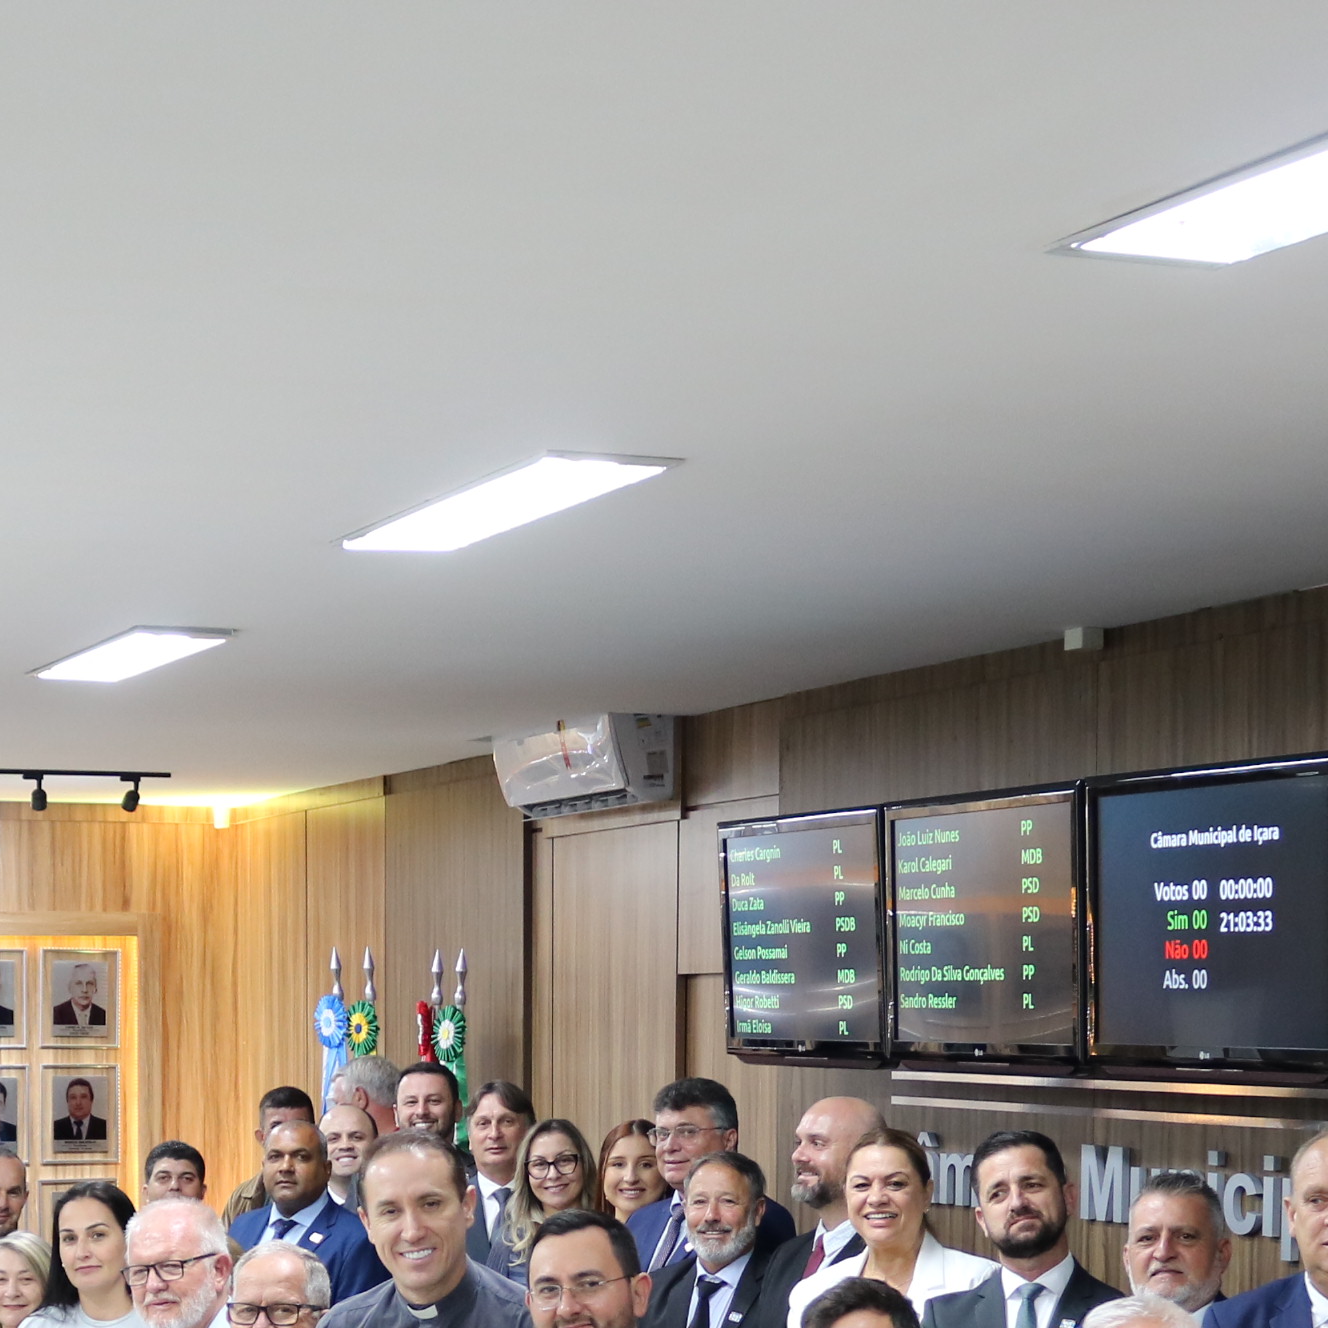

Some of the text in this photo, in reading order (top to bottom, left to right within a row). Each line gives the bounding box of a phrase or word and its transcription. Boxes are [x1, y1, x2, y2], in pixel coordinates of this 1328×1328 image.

[1020, 820, 1033, 836] PP
[897, 829, 960, 848] João Luiz Nunes
[1150, 823, 1280, 850] Câmara Municipal de Içara
[730, 846, 781, 863] Charles Cargnin
[832, 840, 843, 854] PL
[898, 854, 952, 875] Karol Calegari
[1021, 849, 1042, 865] MDB
[731, 872, 755, 887] Da Rolt
[833, 865, 843, 880] PL
[898, 883, 955, 901] Marcelo Cunha
[1022, 878, 1040, 894] PSD
[1154, 877, 1273, 902] Votos 00 00:00:00
[732, 897, 764, 911] Duca Zata
[834, 891, 845, 906] PP
[899, 910, 965, 930] Moacyr Francisco
[1022, 907, 1041, 922] PSD
[1167, 910, 1273, 933] Sim 00 21:03:33
[733, 918, 811, 938] Elisângela Zanolli Vieira
[835, 916, 856, 932] PSDB
[836, 943, 847, 958] PP
[899, 940, 932, 955] Ni Costa
[1022, 936, 1034, 951] PL
[1165, 939, 1208, 960] Não 00
[734, 944, 788, 960] Gelson Possamai
[735, 970, 796, 985] Geraldo Baldissera
[837, 969, 856, 984] MDB
[899, 964, 1005, 985] Rodrigo Da Silva Gonçalves
[1022, 964, 1035, 980] PP
[1162, 969, 1208, 990] Abs. 00
[736, 994, 780, 1012] Higor Robetti
[838, 995, 853, 1011] PSD
[900, 994, 957, 1010] Sandro Ressler
[1022, 993, 1035, 1009] PL
[736, 1019, 772, 1034] Irmã Eloisa
[839, 1021, 849, 1036] PL
